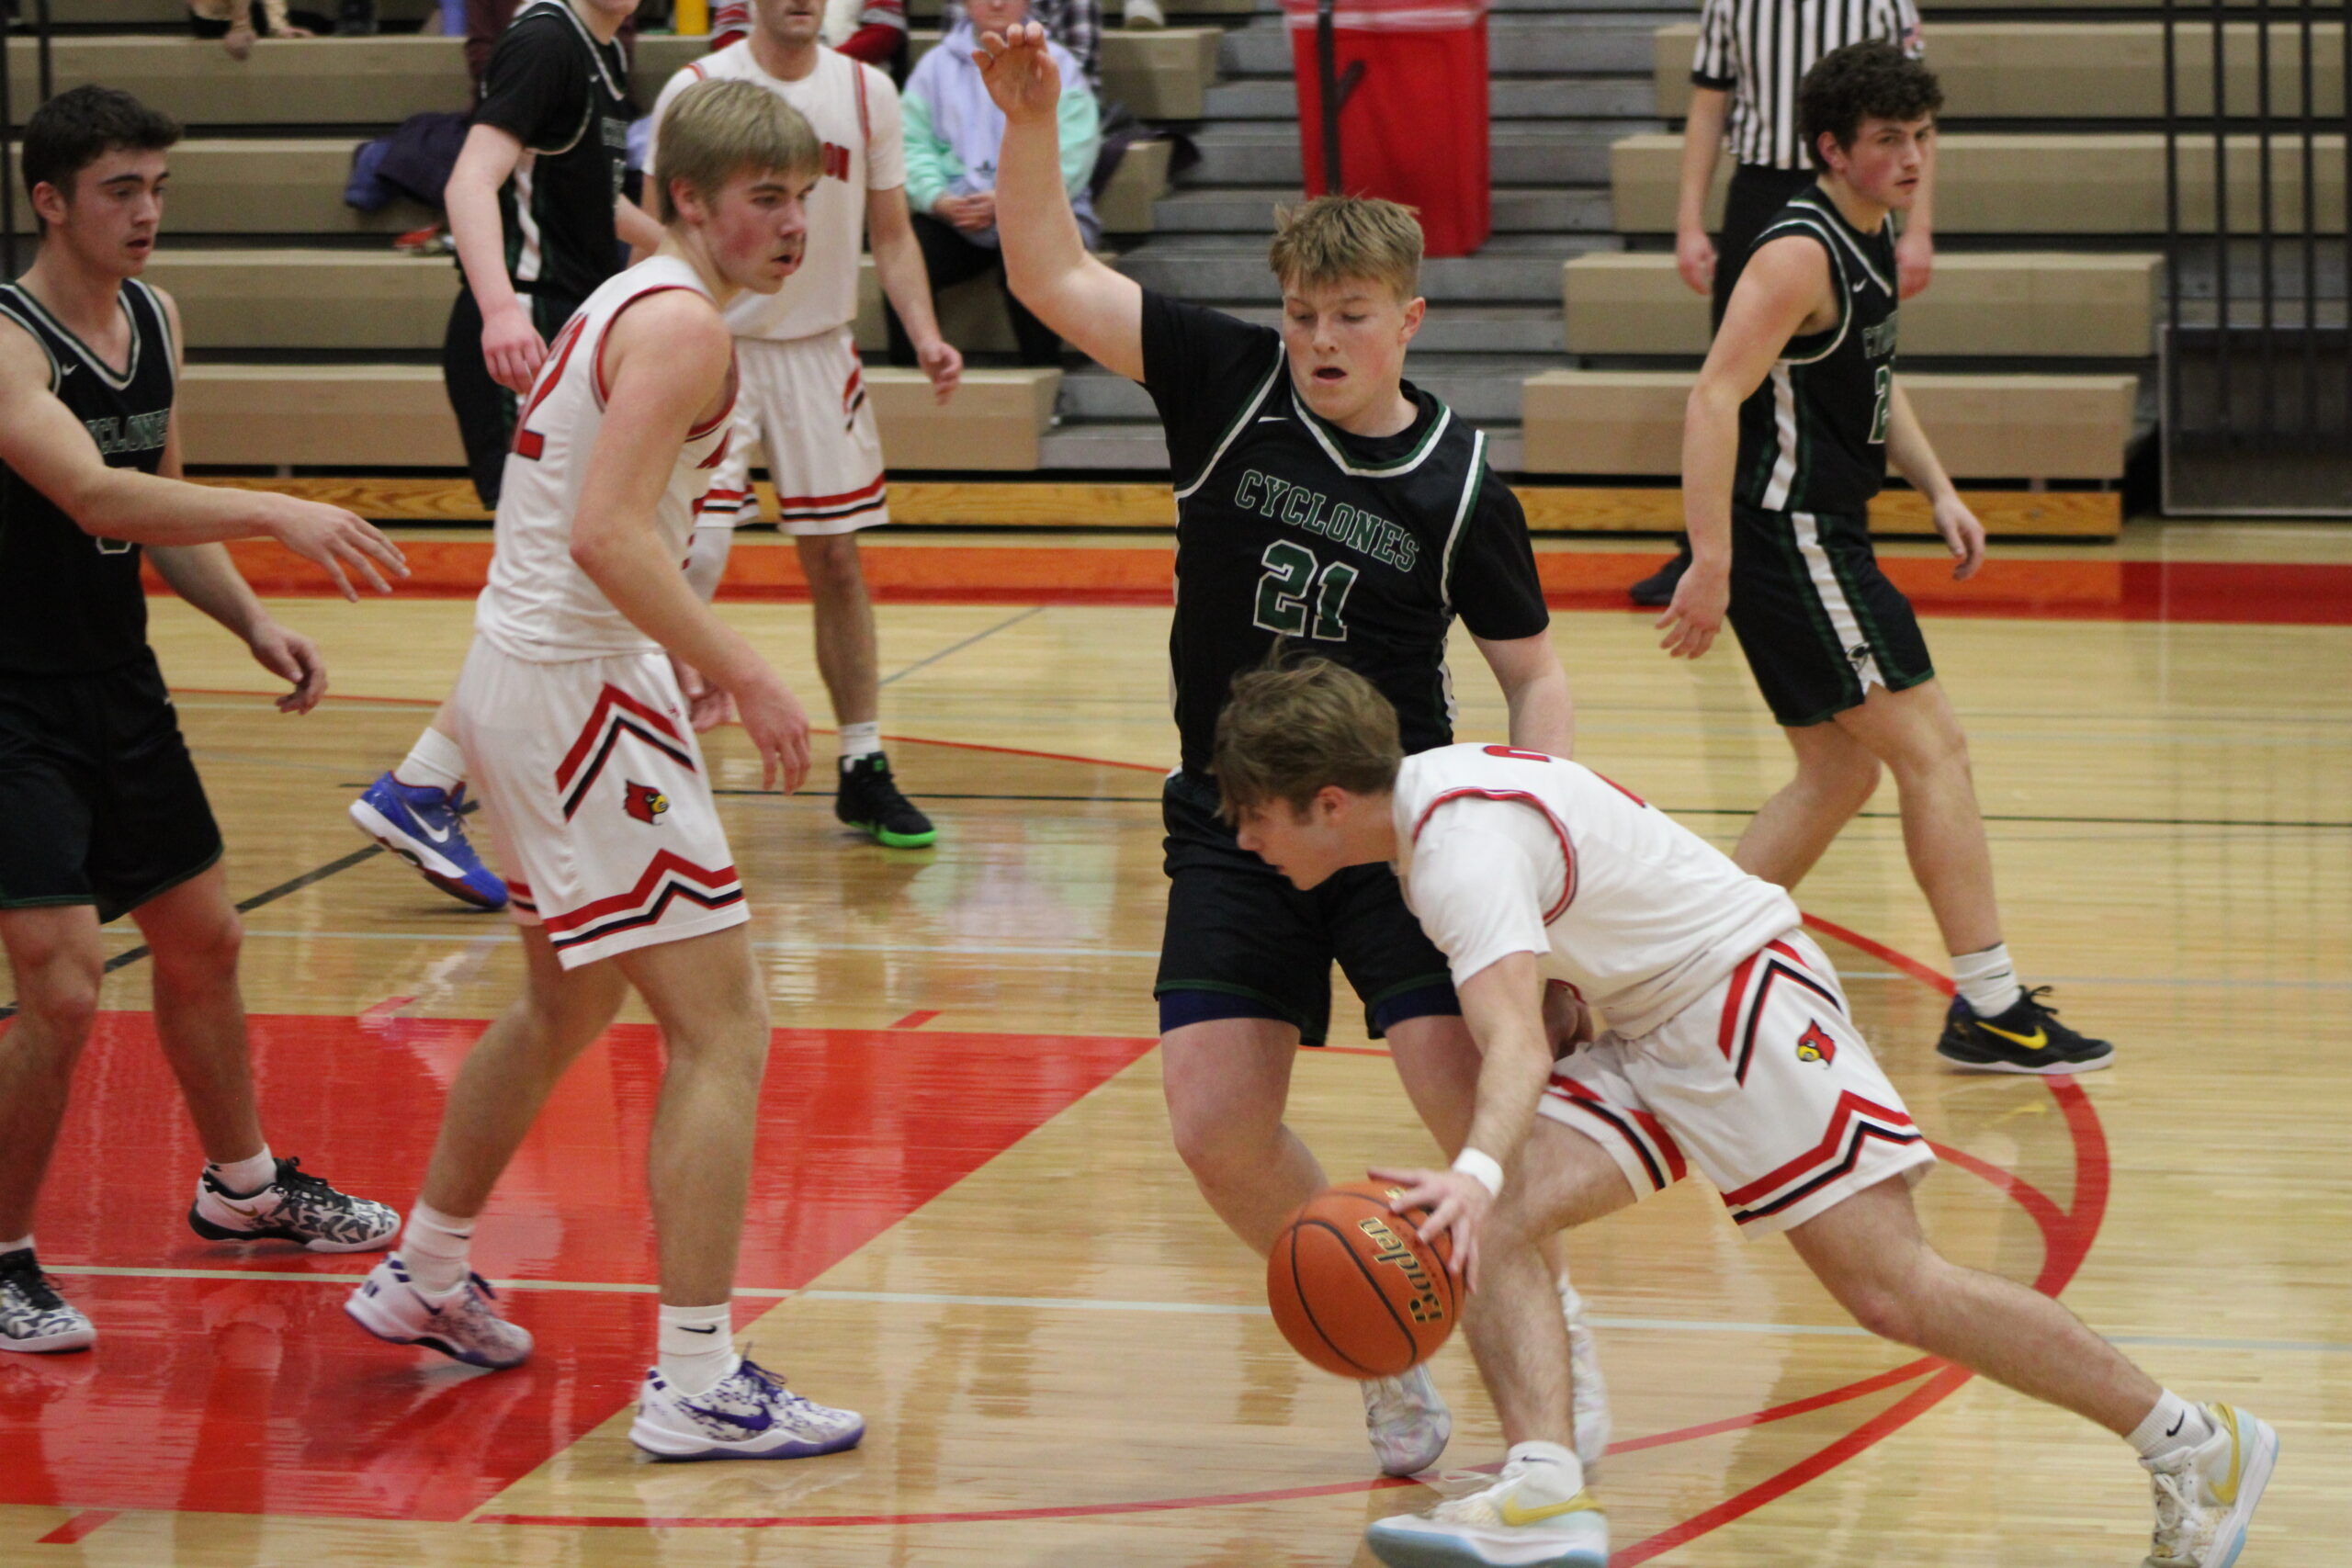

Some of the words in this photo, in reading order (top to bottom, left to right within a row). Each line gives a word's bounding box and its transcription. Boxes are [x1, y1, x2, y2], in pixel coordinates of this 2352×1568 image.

[1235, 469, 1419, 572] CYCLONES
[1253, 539, 1359, 641] 21
[1358, 1216, 1443, 1324] Baden
